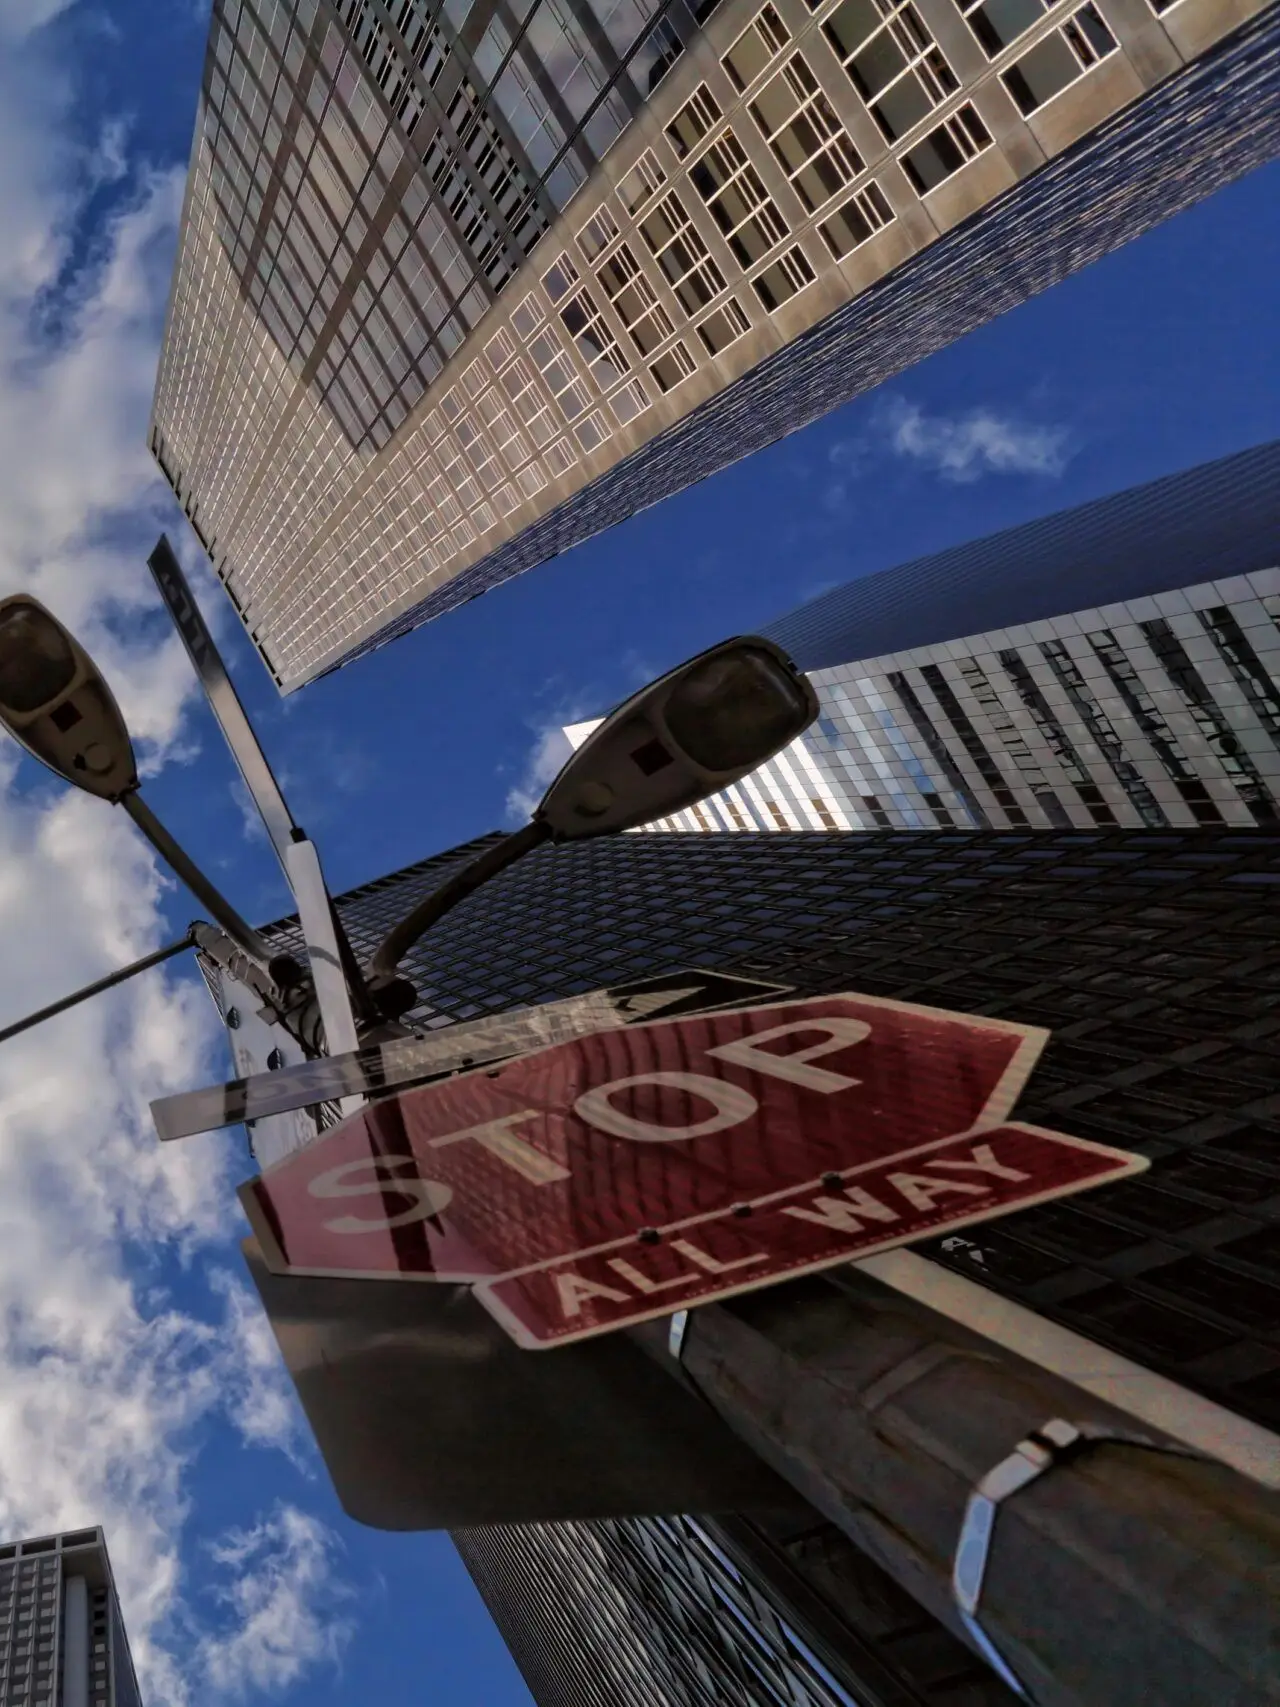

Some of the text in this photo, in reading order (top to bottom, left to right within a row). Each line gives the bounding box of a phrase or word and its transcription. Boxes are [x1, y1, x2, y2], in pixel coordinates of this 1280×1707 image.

[307, 1018, 872, 1234] STOP
[555, 1239, 770, 1319] ALL
[780, 1144, 1031, 1233] WAY
